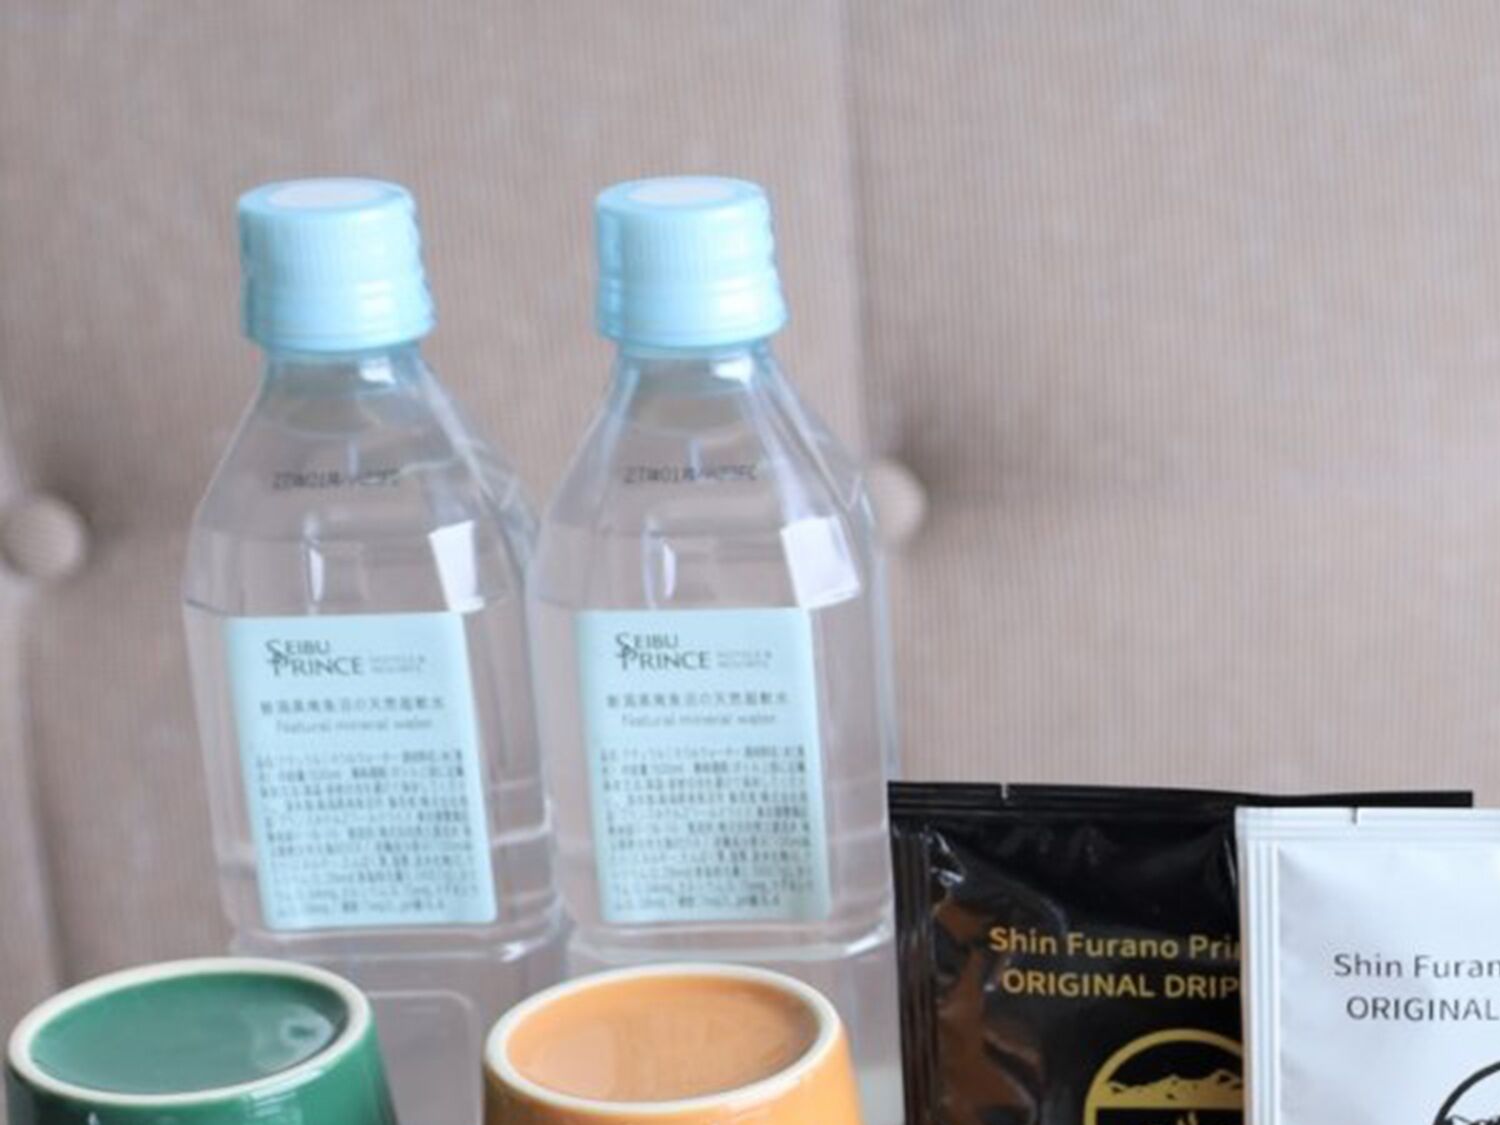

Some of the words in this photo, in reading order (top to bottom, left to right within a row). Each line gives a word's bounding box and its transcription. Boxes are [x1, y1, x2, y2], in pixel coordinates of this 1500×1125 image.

[264, 639, 332, 660] SEIBU
[614, 631, 679, 650] SEIBU
[266, 653, 365, 677] PRINCE
[615, 646, 711, 670] PRINCE
[989, 927, 1058, 956] Shin
[1067, 932, 1179, 960] Furano
[1333, 952, 1403, 980] Shin
[1002, 968, 1156, 998] ORIGINAL
[1164, 974, 1241, 999] DRIP
[1346, 995, 1500, 1022] ORIGINAL
